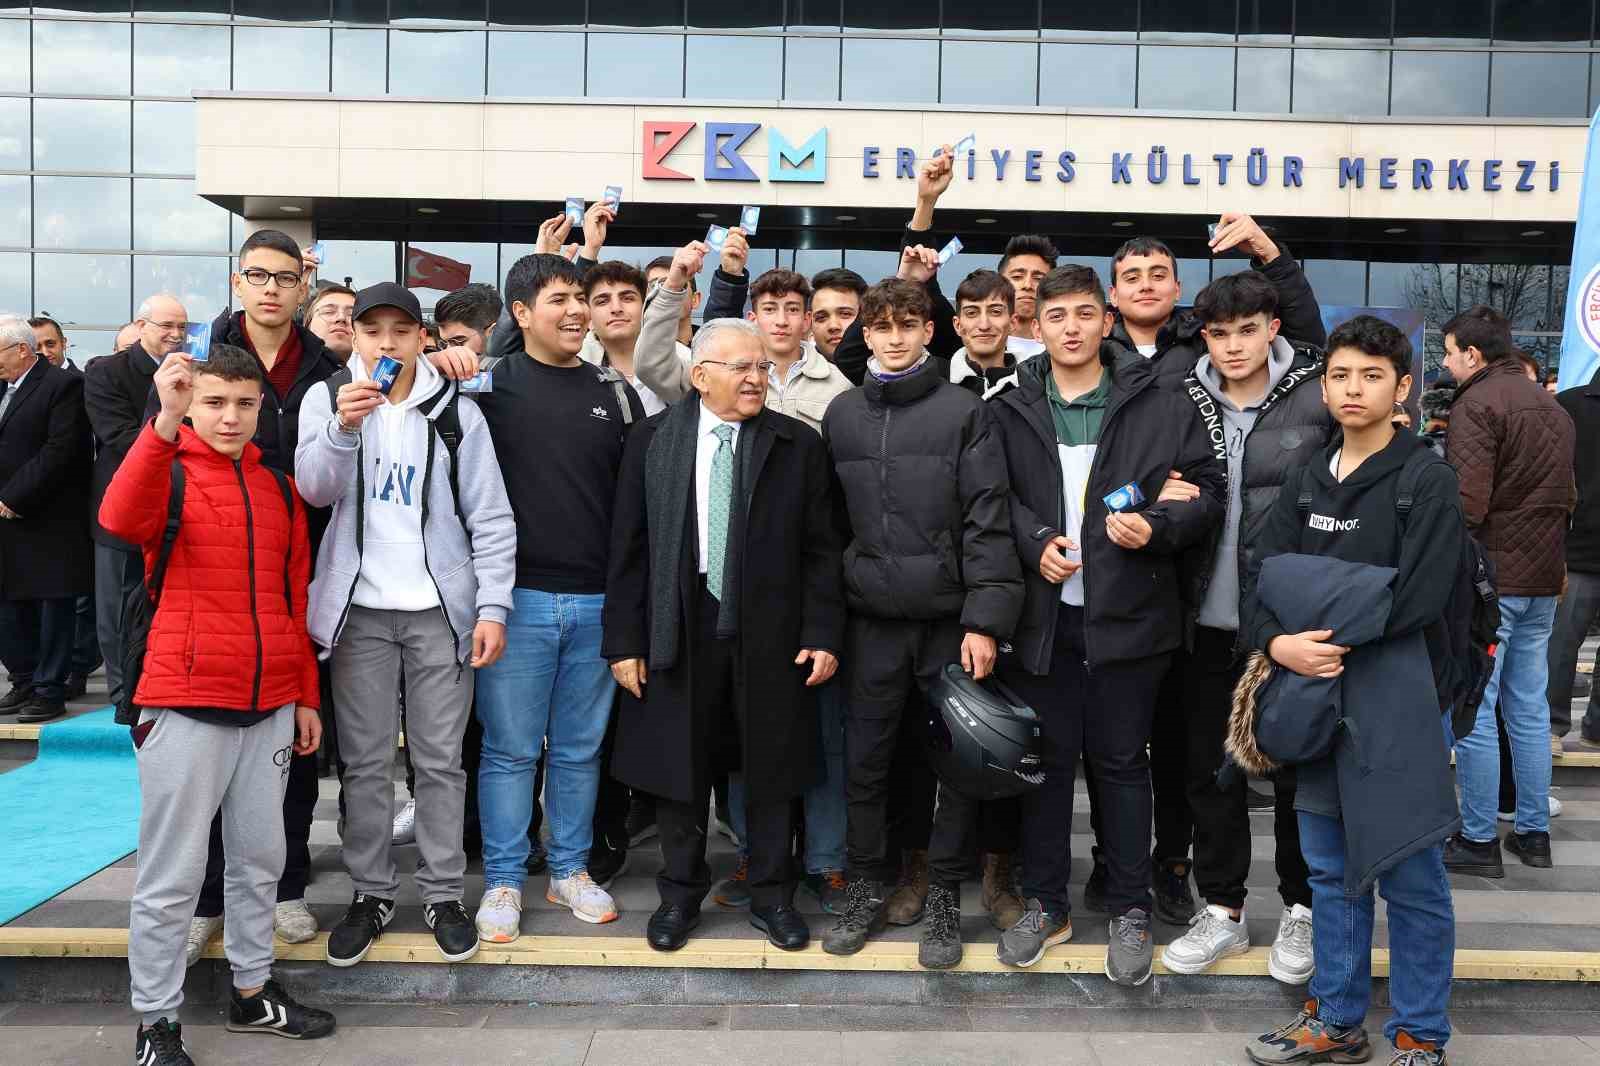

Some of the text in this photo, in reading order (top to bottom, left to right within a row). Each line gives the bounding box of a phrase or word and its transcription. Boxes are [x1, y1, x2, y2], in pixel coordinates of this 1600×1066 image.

[863, 146, 1076, 183] ERİYES
[1111, 145, 1304, 188] KÜLTÜR
[1187, 384, 1227, 460] MONCLER
[1309, 514, 1335, 531] WHY
